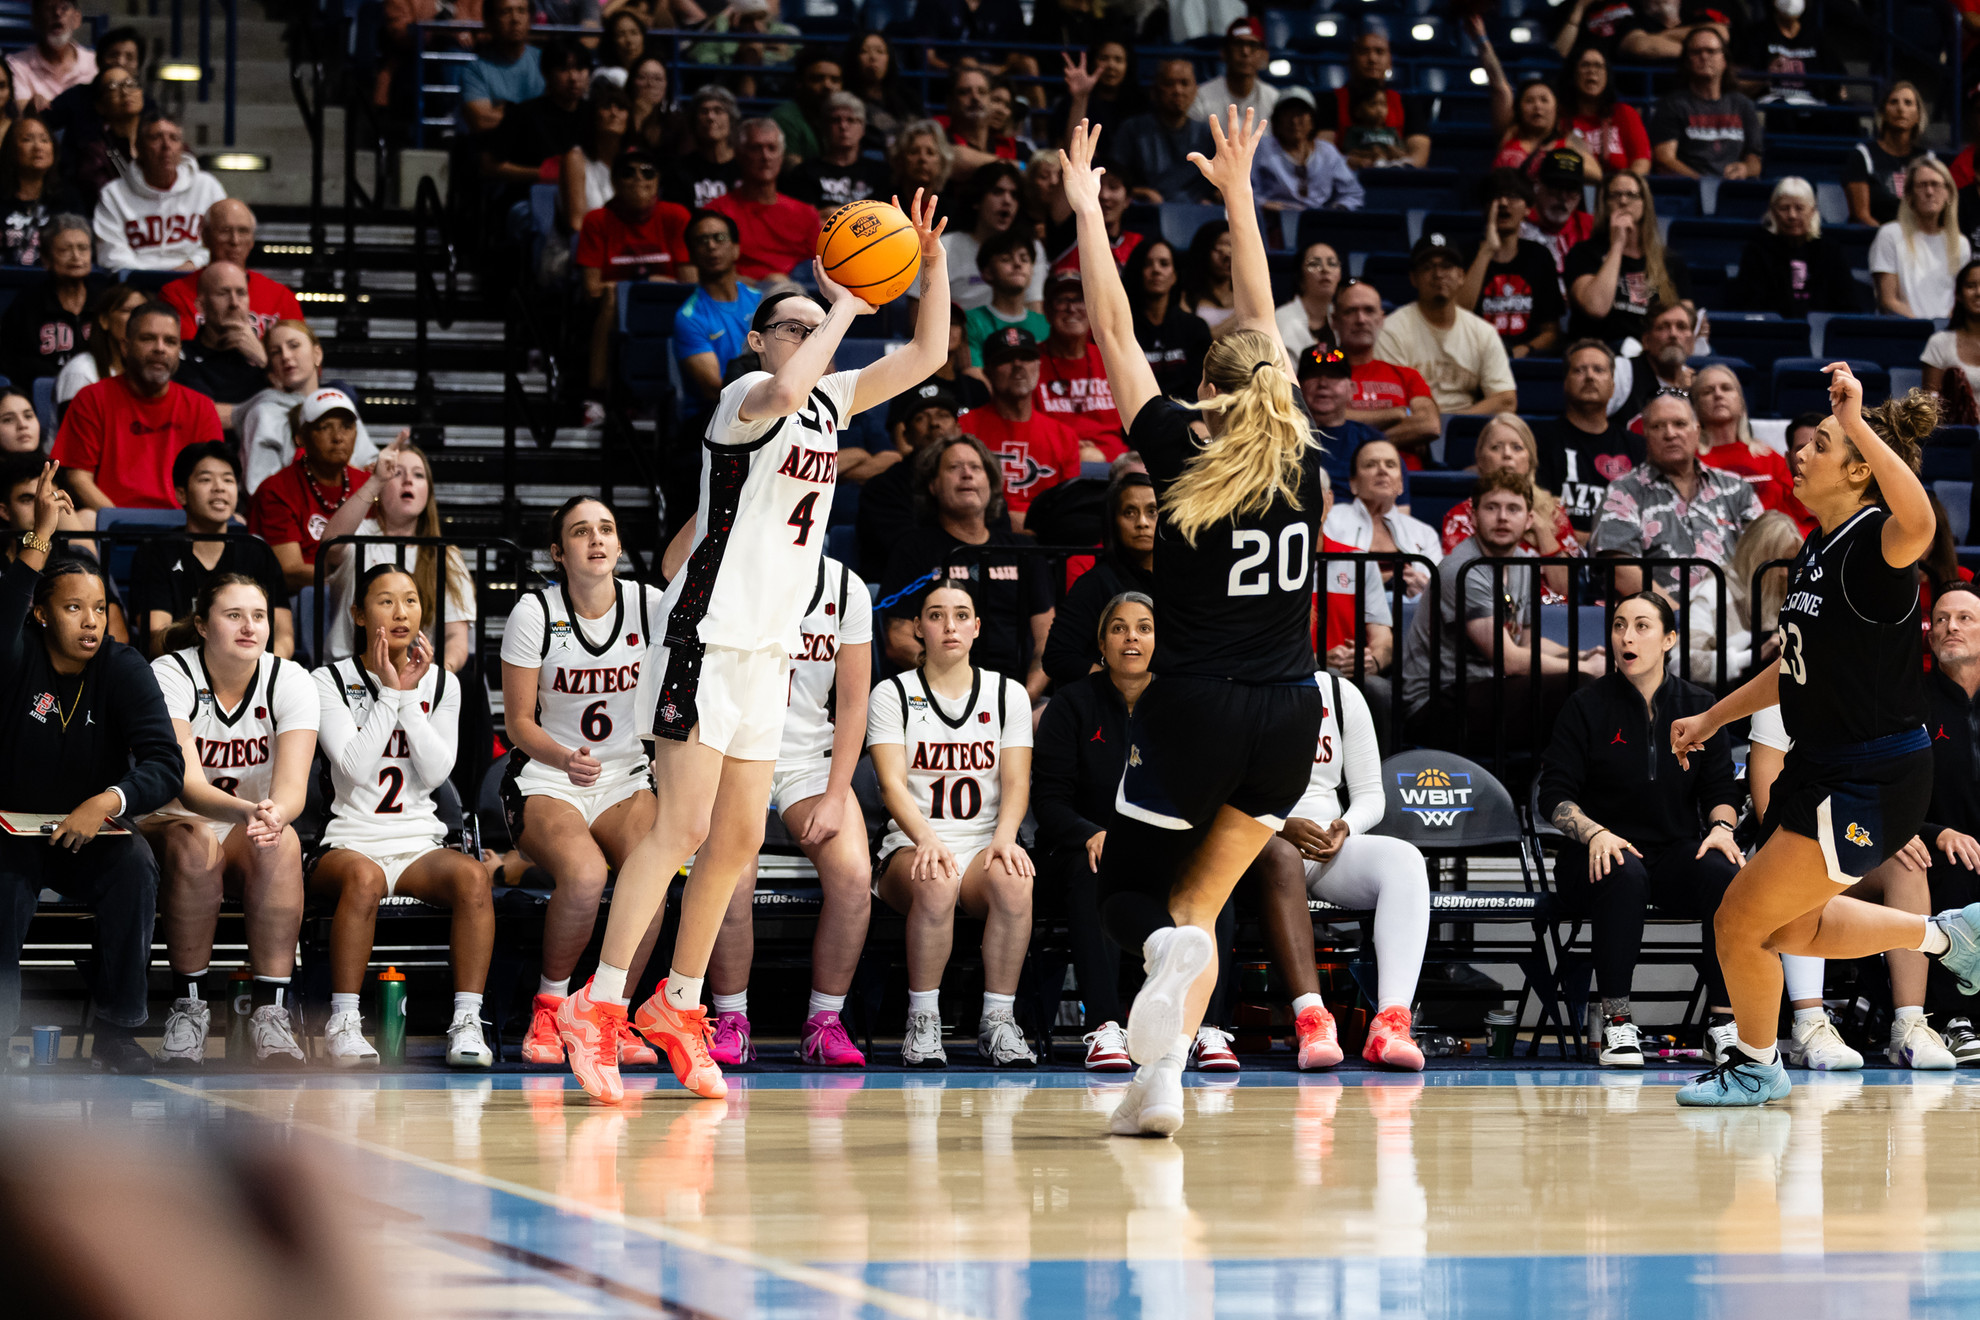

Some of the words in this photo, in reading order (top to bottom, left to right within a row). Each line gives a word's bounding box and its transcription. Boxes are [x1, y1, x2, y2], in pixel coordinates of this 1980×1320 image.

[1565, 448, 1579, 482] I
[787, 491, 821, 546] 4
[1227, 521, 1309, 596] 20
[552, 661, 641, 694] AZTECS
[580, 700, 613, 742] 6
[911, 740, 996, 771] AZTECS
[374, 765, 405, 814] 2
[929, 775, 982, 820] 10
[1399, 788, 1473, 805] WBIT
[1433, 895, 1536, 908] USDToreros.com
[233, 994, 252, 1015] G
